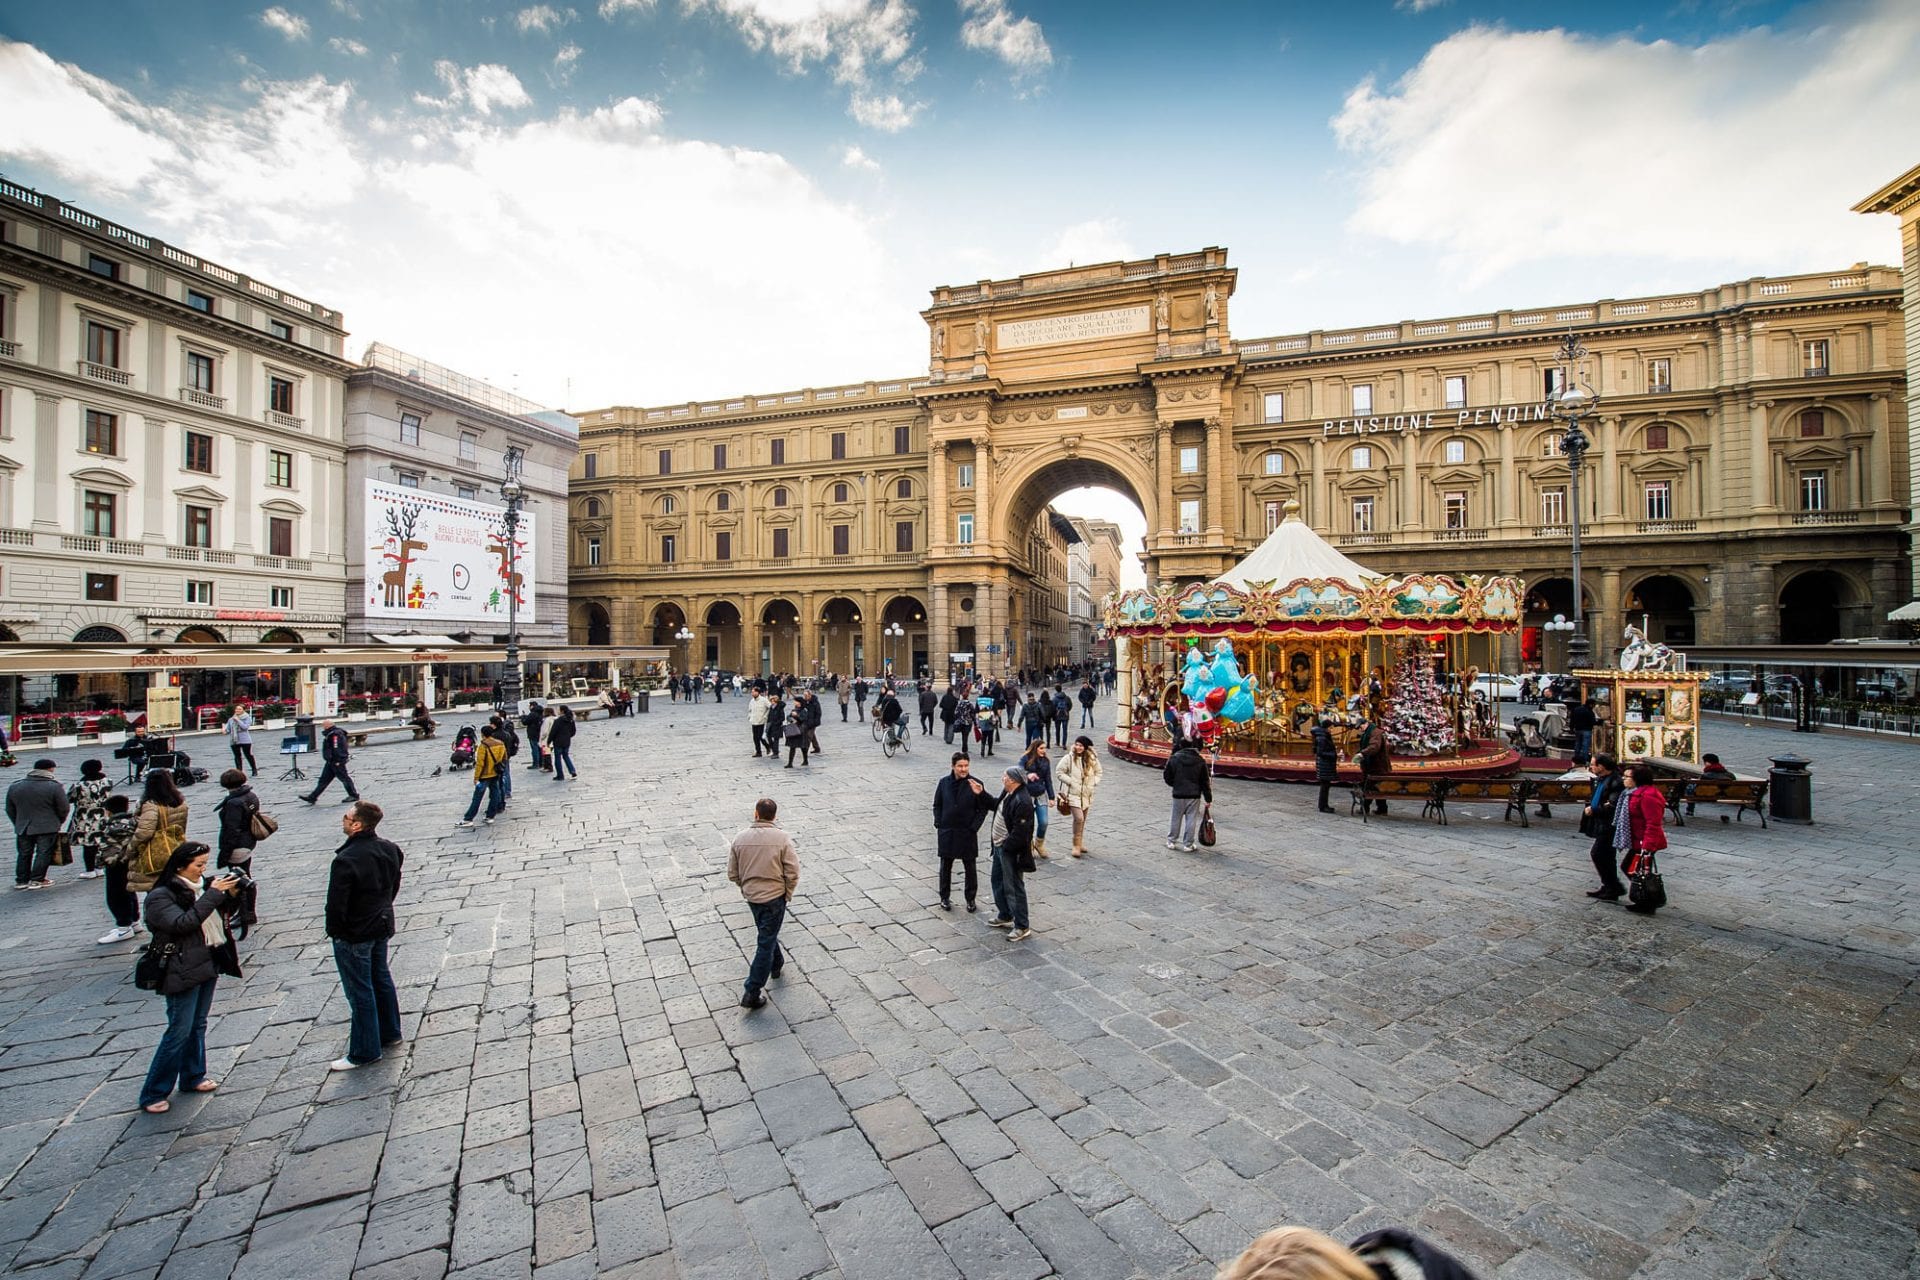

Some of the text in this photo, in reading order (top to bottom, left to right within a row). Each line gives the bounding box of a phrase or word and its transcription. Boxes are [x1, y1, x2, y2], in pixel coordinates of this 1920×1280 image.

[1044, 316, 1080, 327] CENTRO
[1083, 311, 1114, 321] DELLA
[1077, 317, 1130, 330] SQUALLORE
[1078, 324, 1133, 337] RESTITUITO
[1323, 412, 1435, 436] PENSIONE
[438, 524, 454, 534] BELLE
[434, 532, 454, 543] BUONO
[131, 655, 198, 667] pescerosso
